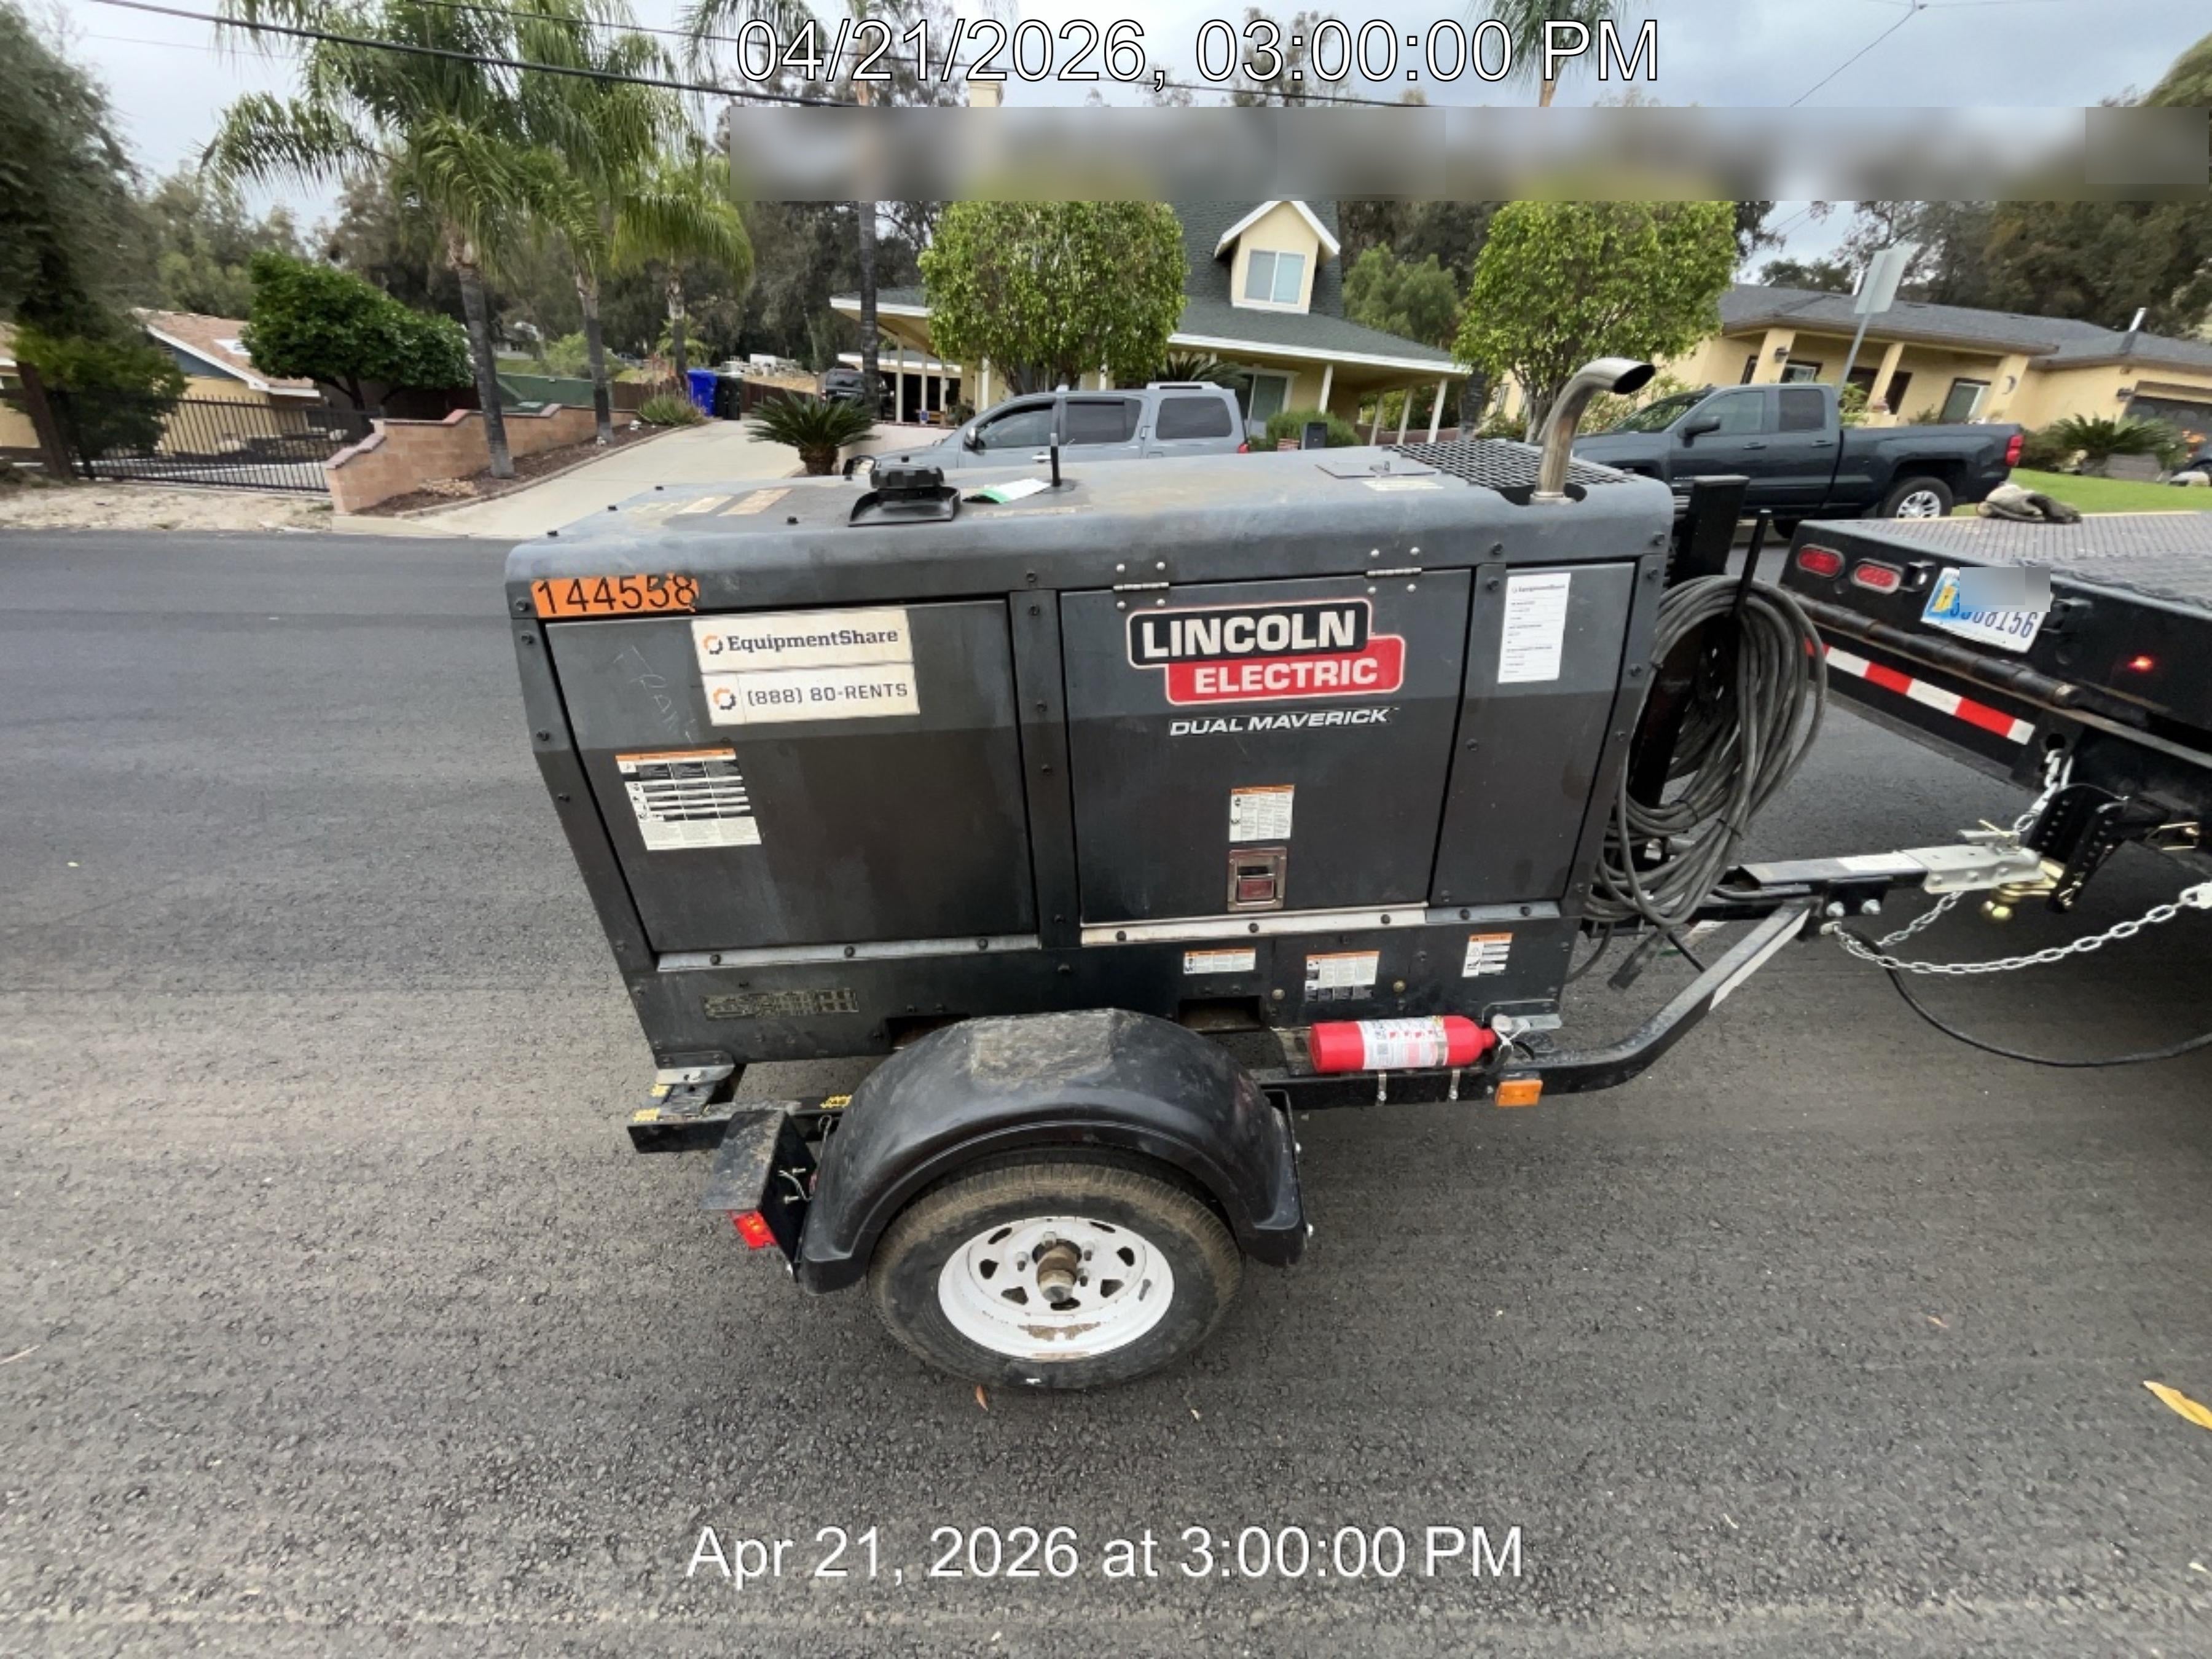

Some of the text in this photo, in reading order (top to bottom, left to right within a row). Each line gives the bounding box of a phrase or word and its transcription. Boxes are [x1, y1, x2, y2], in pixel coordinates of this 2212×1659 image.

[538, 573, 696, 614] 144558
[727, 629, 899, 653] EquipmentShare
[1143, 610, 1356, 659] LINCOLN
[1194, 657, 1379, 694] ELECTRIC
[747, 683, 908, 707] (888) 80-RENTS
[1169, 707, 1390, 737] DUAL MAVERICK
